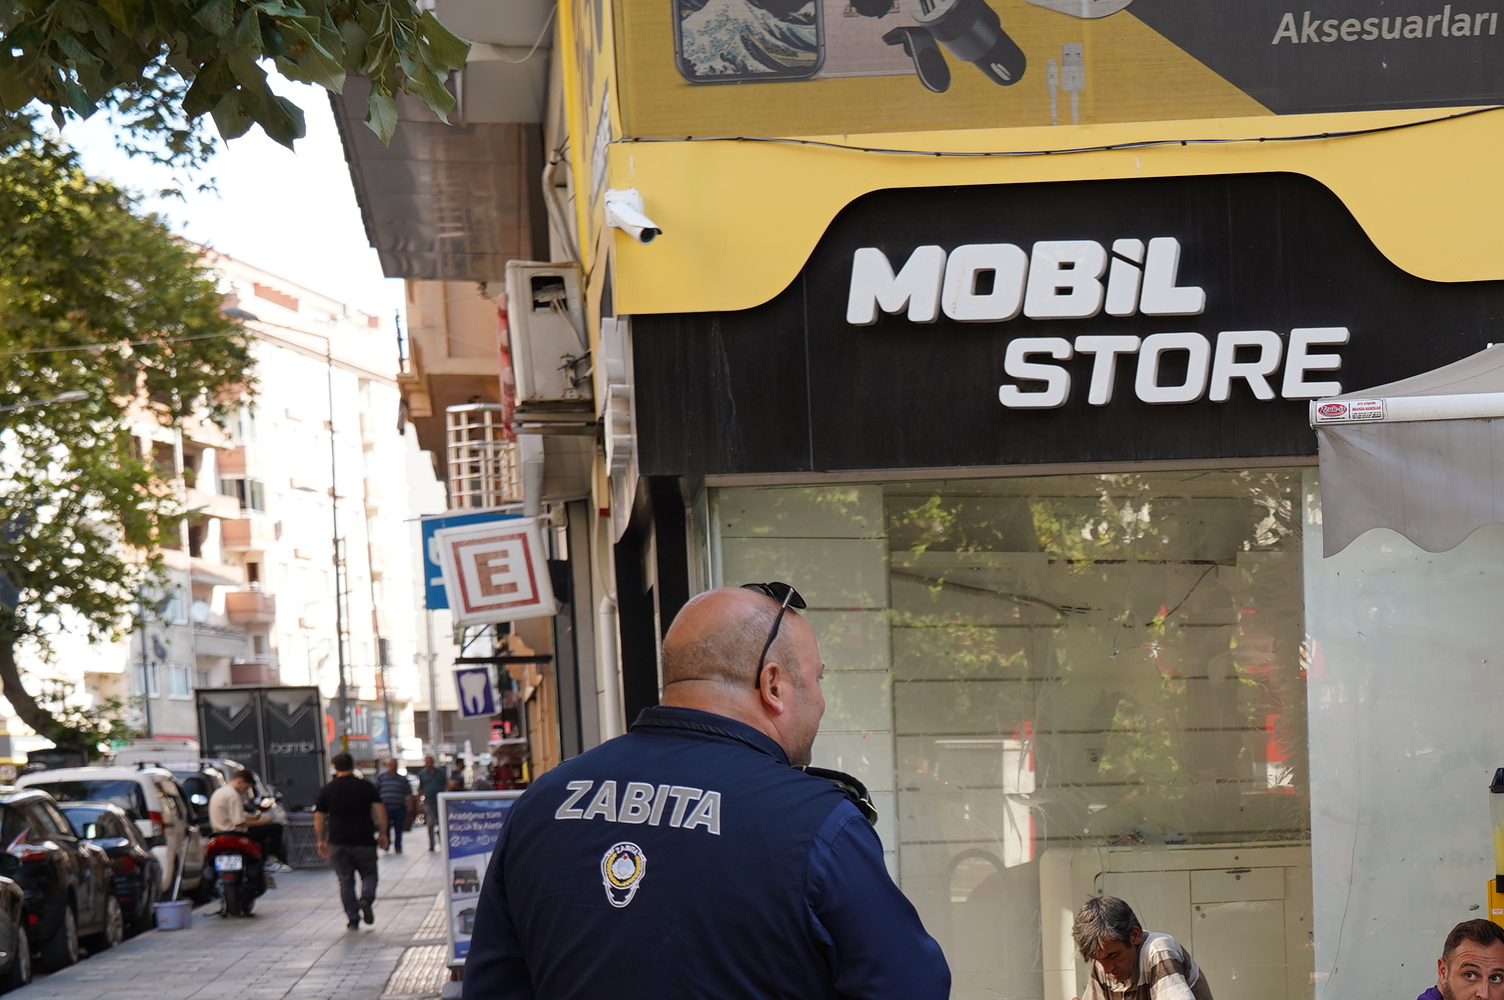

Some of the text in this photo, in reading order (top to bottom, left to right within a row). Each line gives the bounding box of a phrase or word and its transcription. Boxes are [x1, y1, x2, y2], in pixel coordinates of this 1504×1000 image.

[1271, 4, 1498, 45] Aksesuarları
[998, 326, 1350, 409] STORE
[474, 550, 519, 597] E
[554, 780, 722, 836] ZABITA
[614, 844, 640, 856] ZABITA
